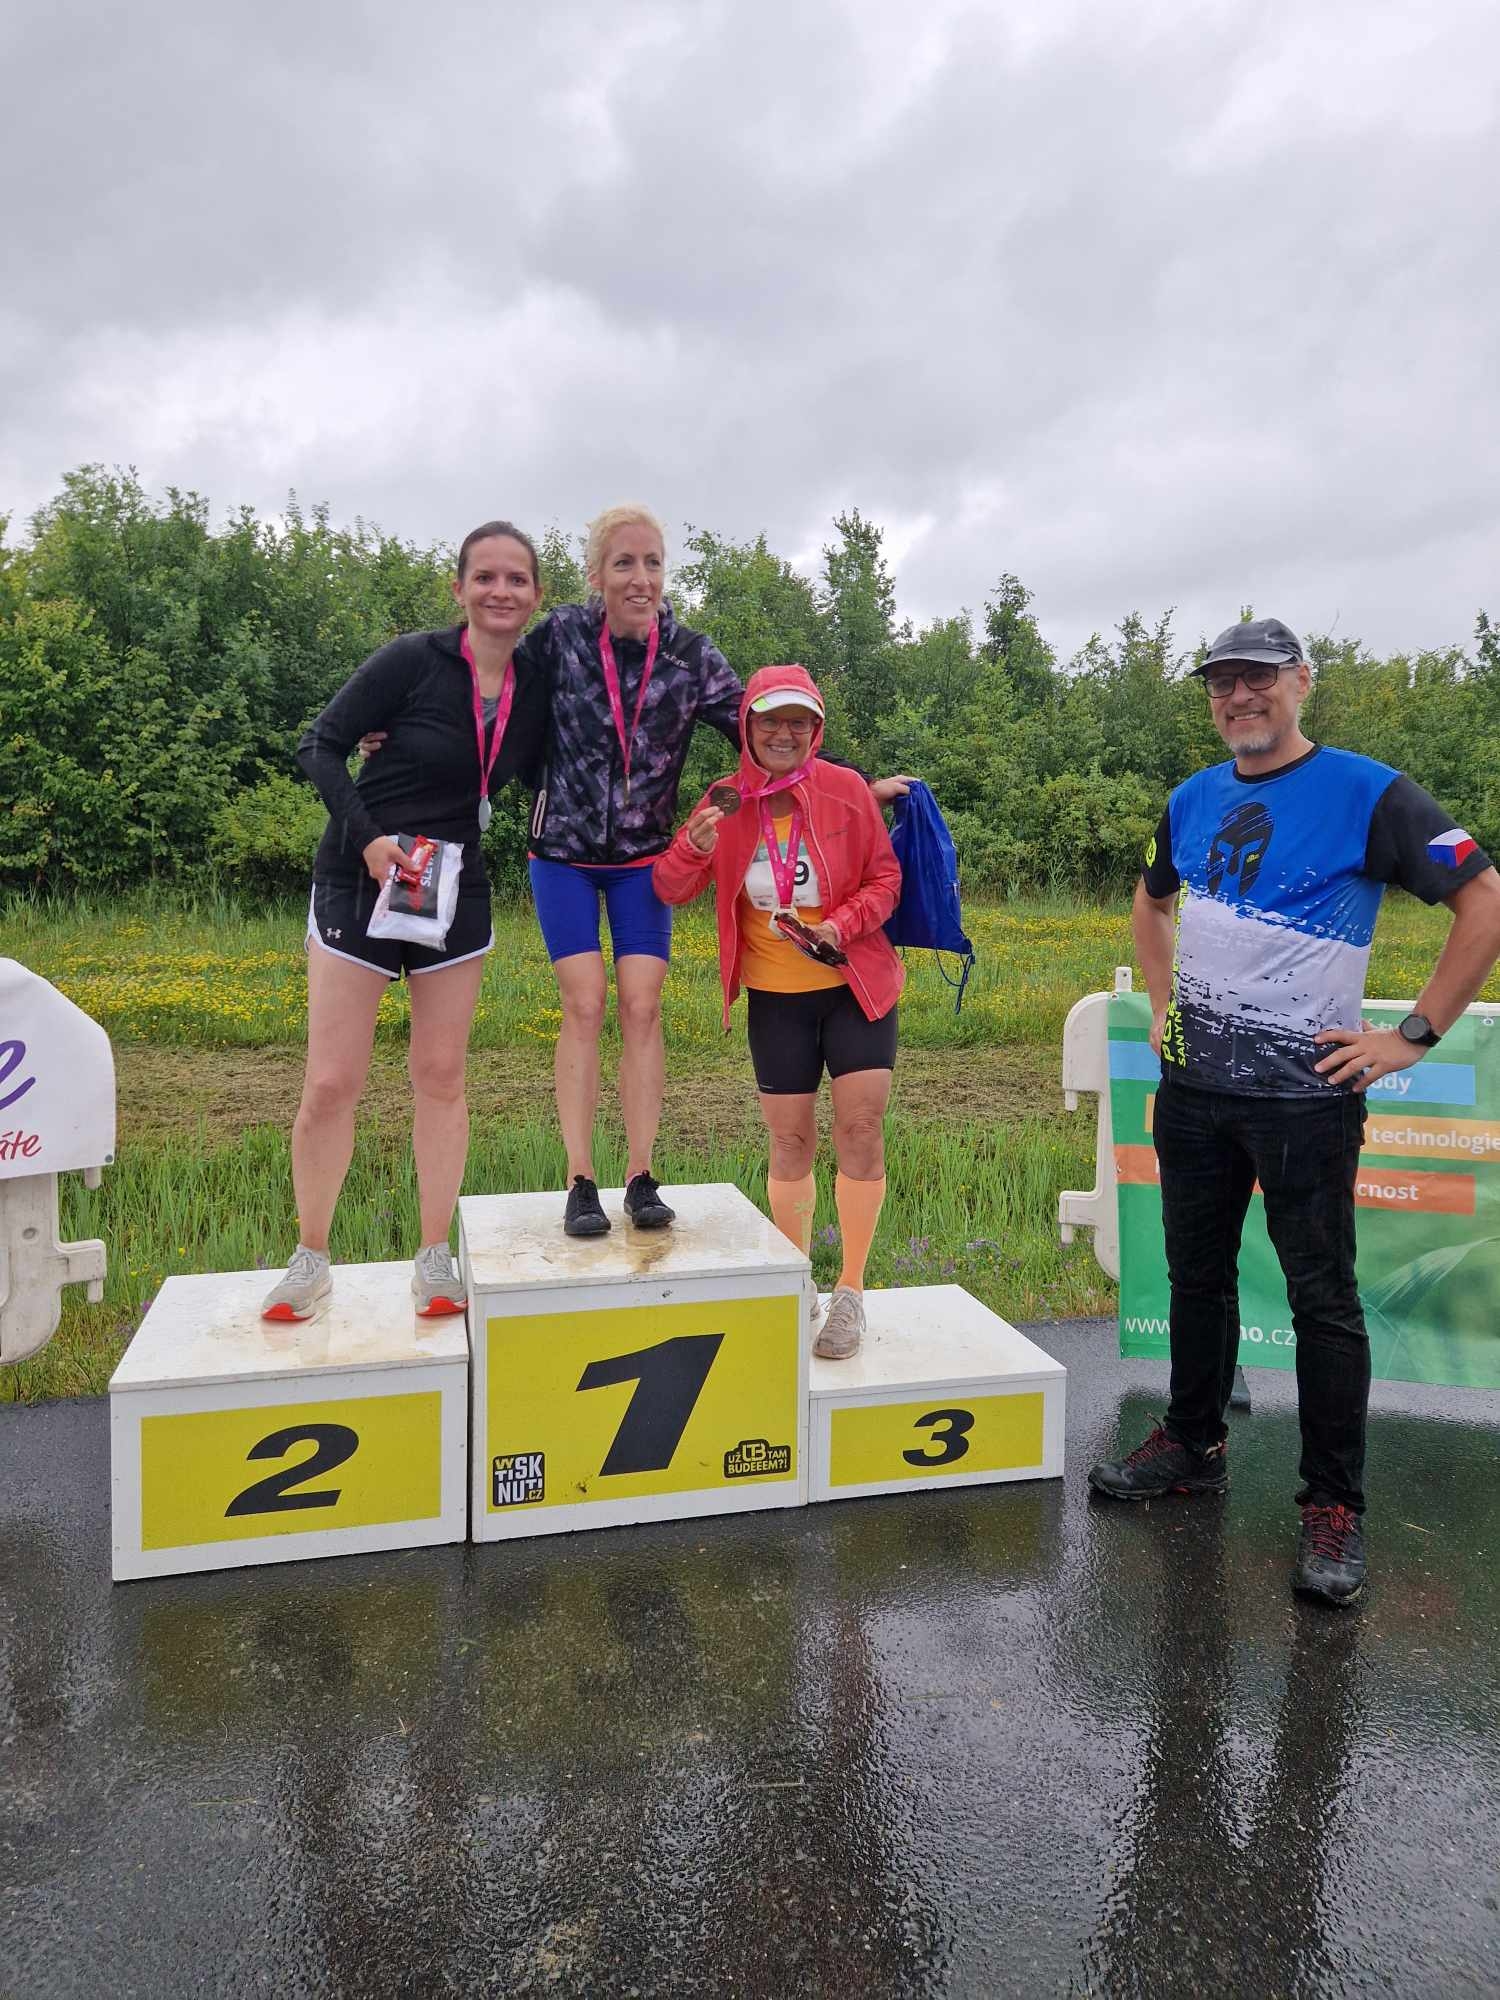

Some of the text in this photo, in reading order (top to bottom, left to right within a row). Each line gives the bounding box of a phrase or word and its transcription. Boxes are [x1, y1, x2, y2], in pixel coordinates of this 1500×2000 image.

[575, 1332, 726, 1477] 1
[902, 1408, 976, 1467] 3
[224, 1423, 360, 1518] 2
[767, 1449, 788, 1460] TAM
